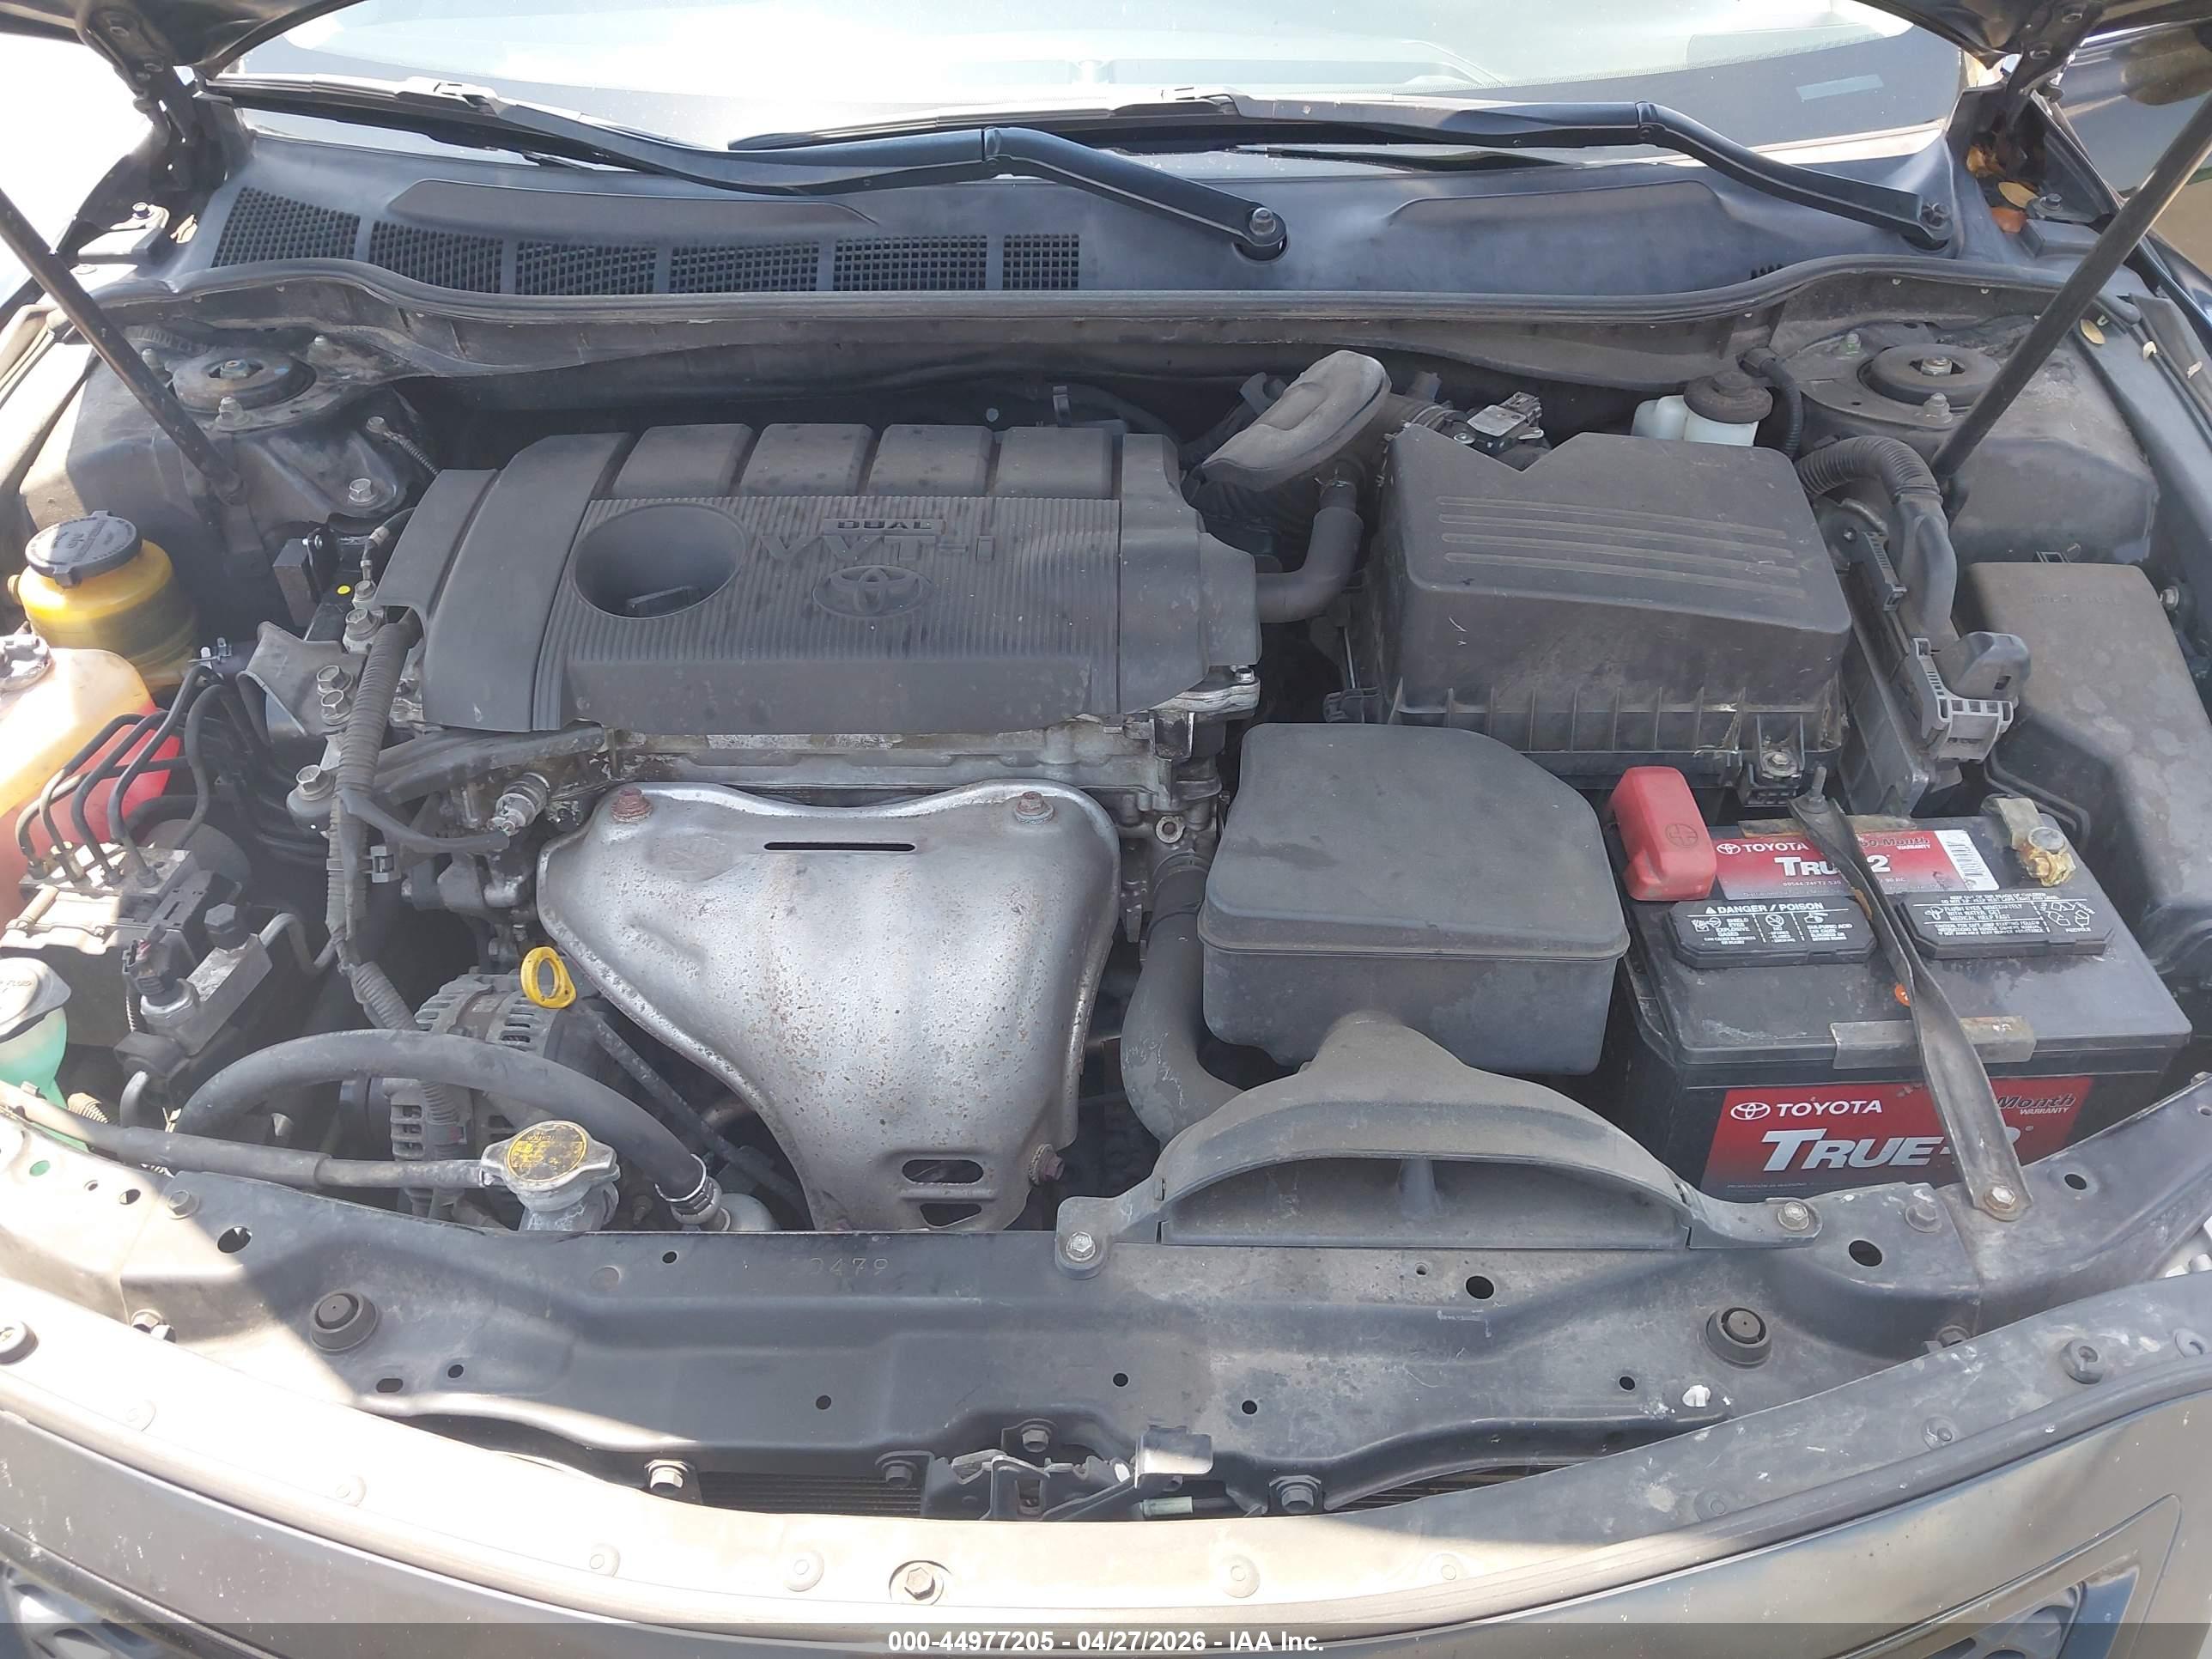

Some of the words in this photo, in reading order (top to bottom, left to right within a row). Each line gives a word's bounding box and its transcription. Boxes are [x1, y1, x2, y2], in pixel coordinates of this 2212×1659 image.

[837, 520, 933, 530] DUAL
[1742, 842, 1809, 853] TOYOTA
[1717, 904, 1768, 914] DANGER
[1778, 902, 1824, 911] POISON
[1997, 1094, 2076, 1109] Month
[1776, 1100, 1882, 1117] TOYOTA
[2020, 1106, 2070, 1115] WARRANTY
